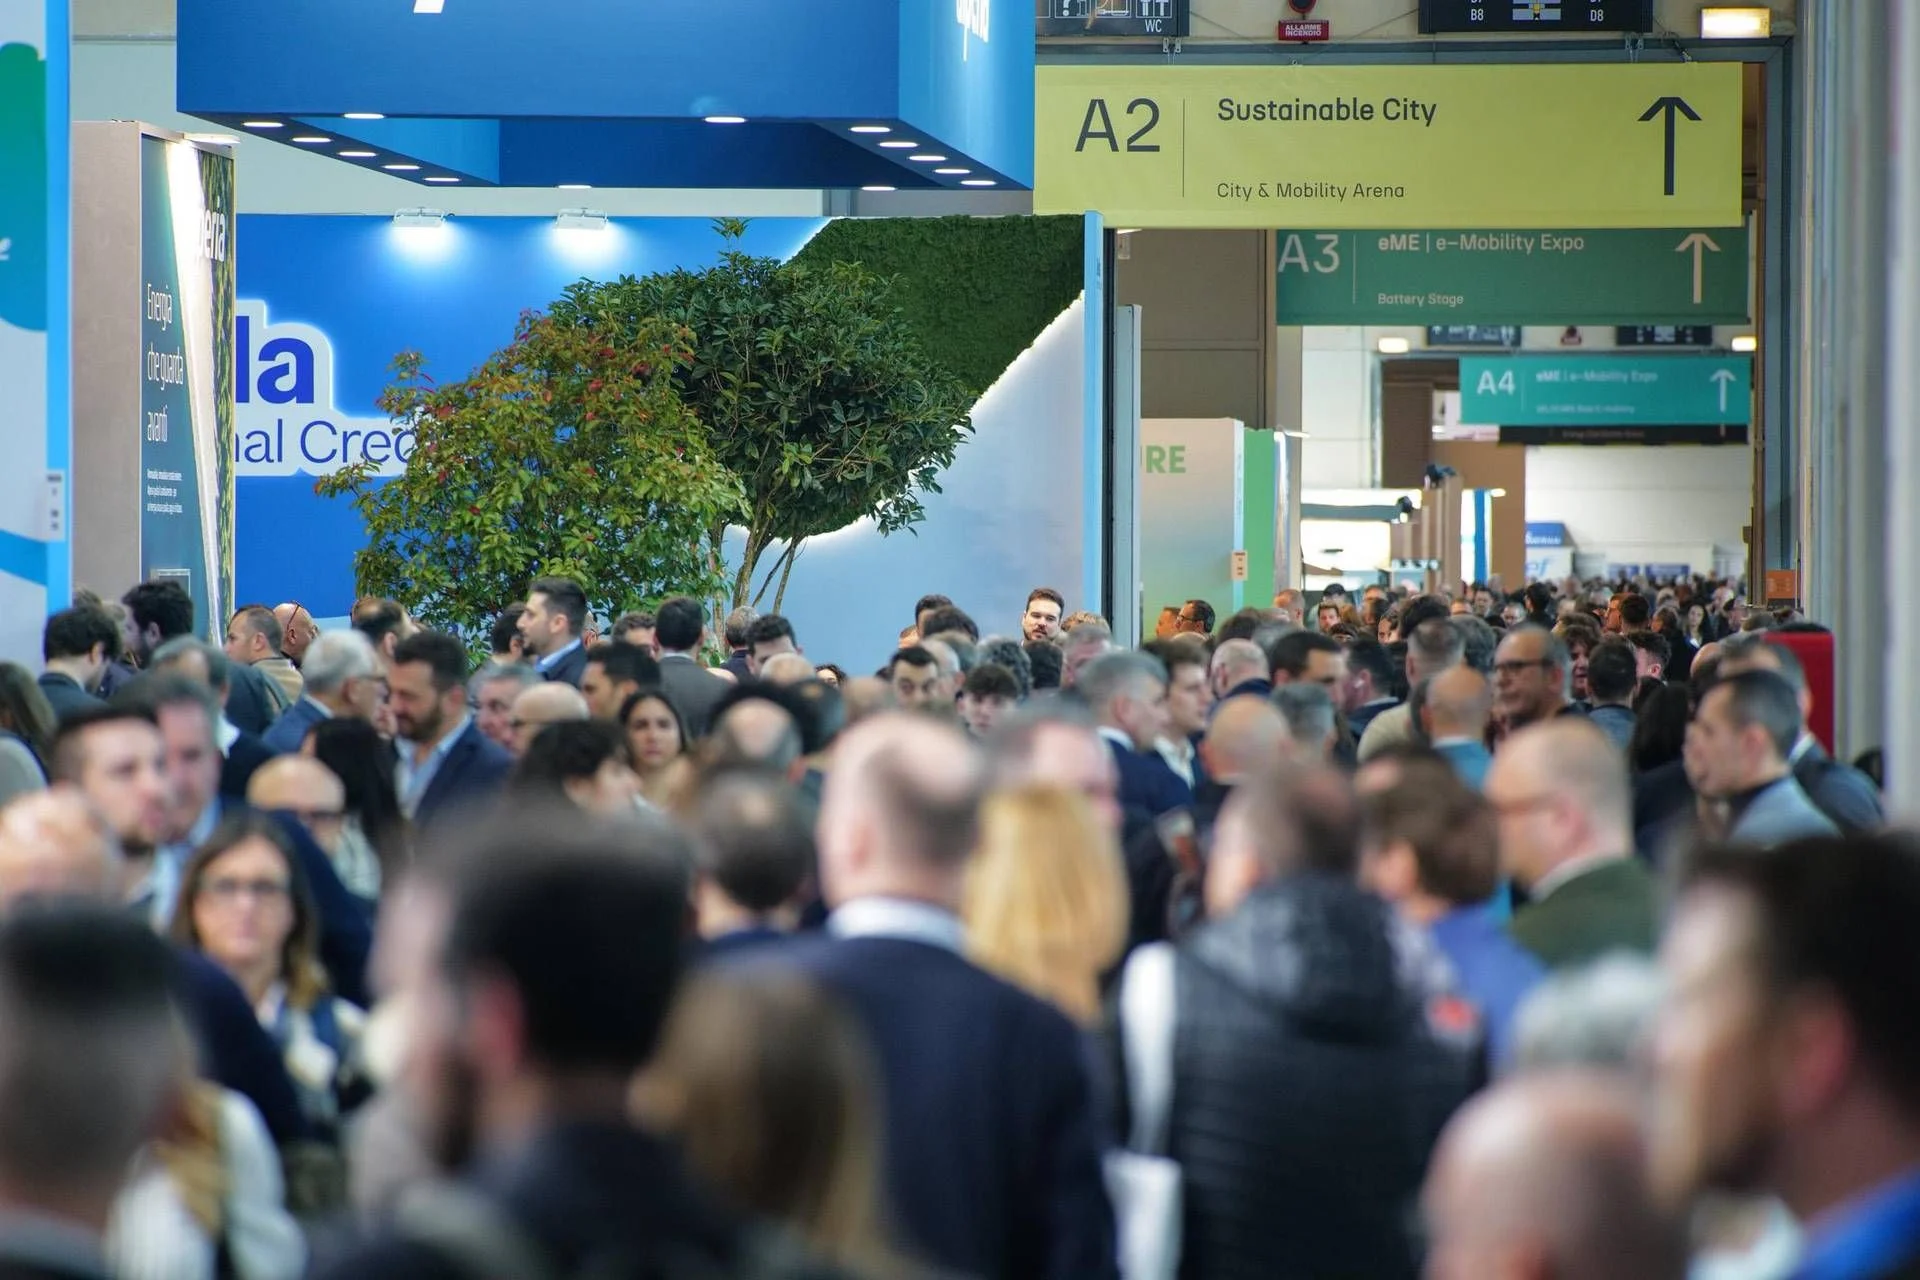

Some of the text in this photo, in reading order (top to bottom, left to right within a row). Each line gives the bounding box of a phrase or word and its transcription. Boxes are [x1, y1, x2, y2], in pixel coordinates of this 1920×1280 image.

[1470, 8, 1484, 21] B8
[1590, 9, 1604, 22] D8
[1145, 19, 1163, 33] WC
[1217, 96, 1437, 127] Sustainable City
[1075, 98, 1161, 153] A2
[1217, 182, 1405, 202] City & Mobility Arena
[1277, 234, 1340, 273] A3
[1378, 234, 1420, 252] eME
[1541, 234, 1584, 254] Expo
[147, 283, 173, 331] Energia
[1378, 293, 1464, 308] Battery Stage
[1476, 370, 1516, 395] A4
[1140, 445, 1187, 474] RE
